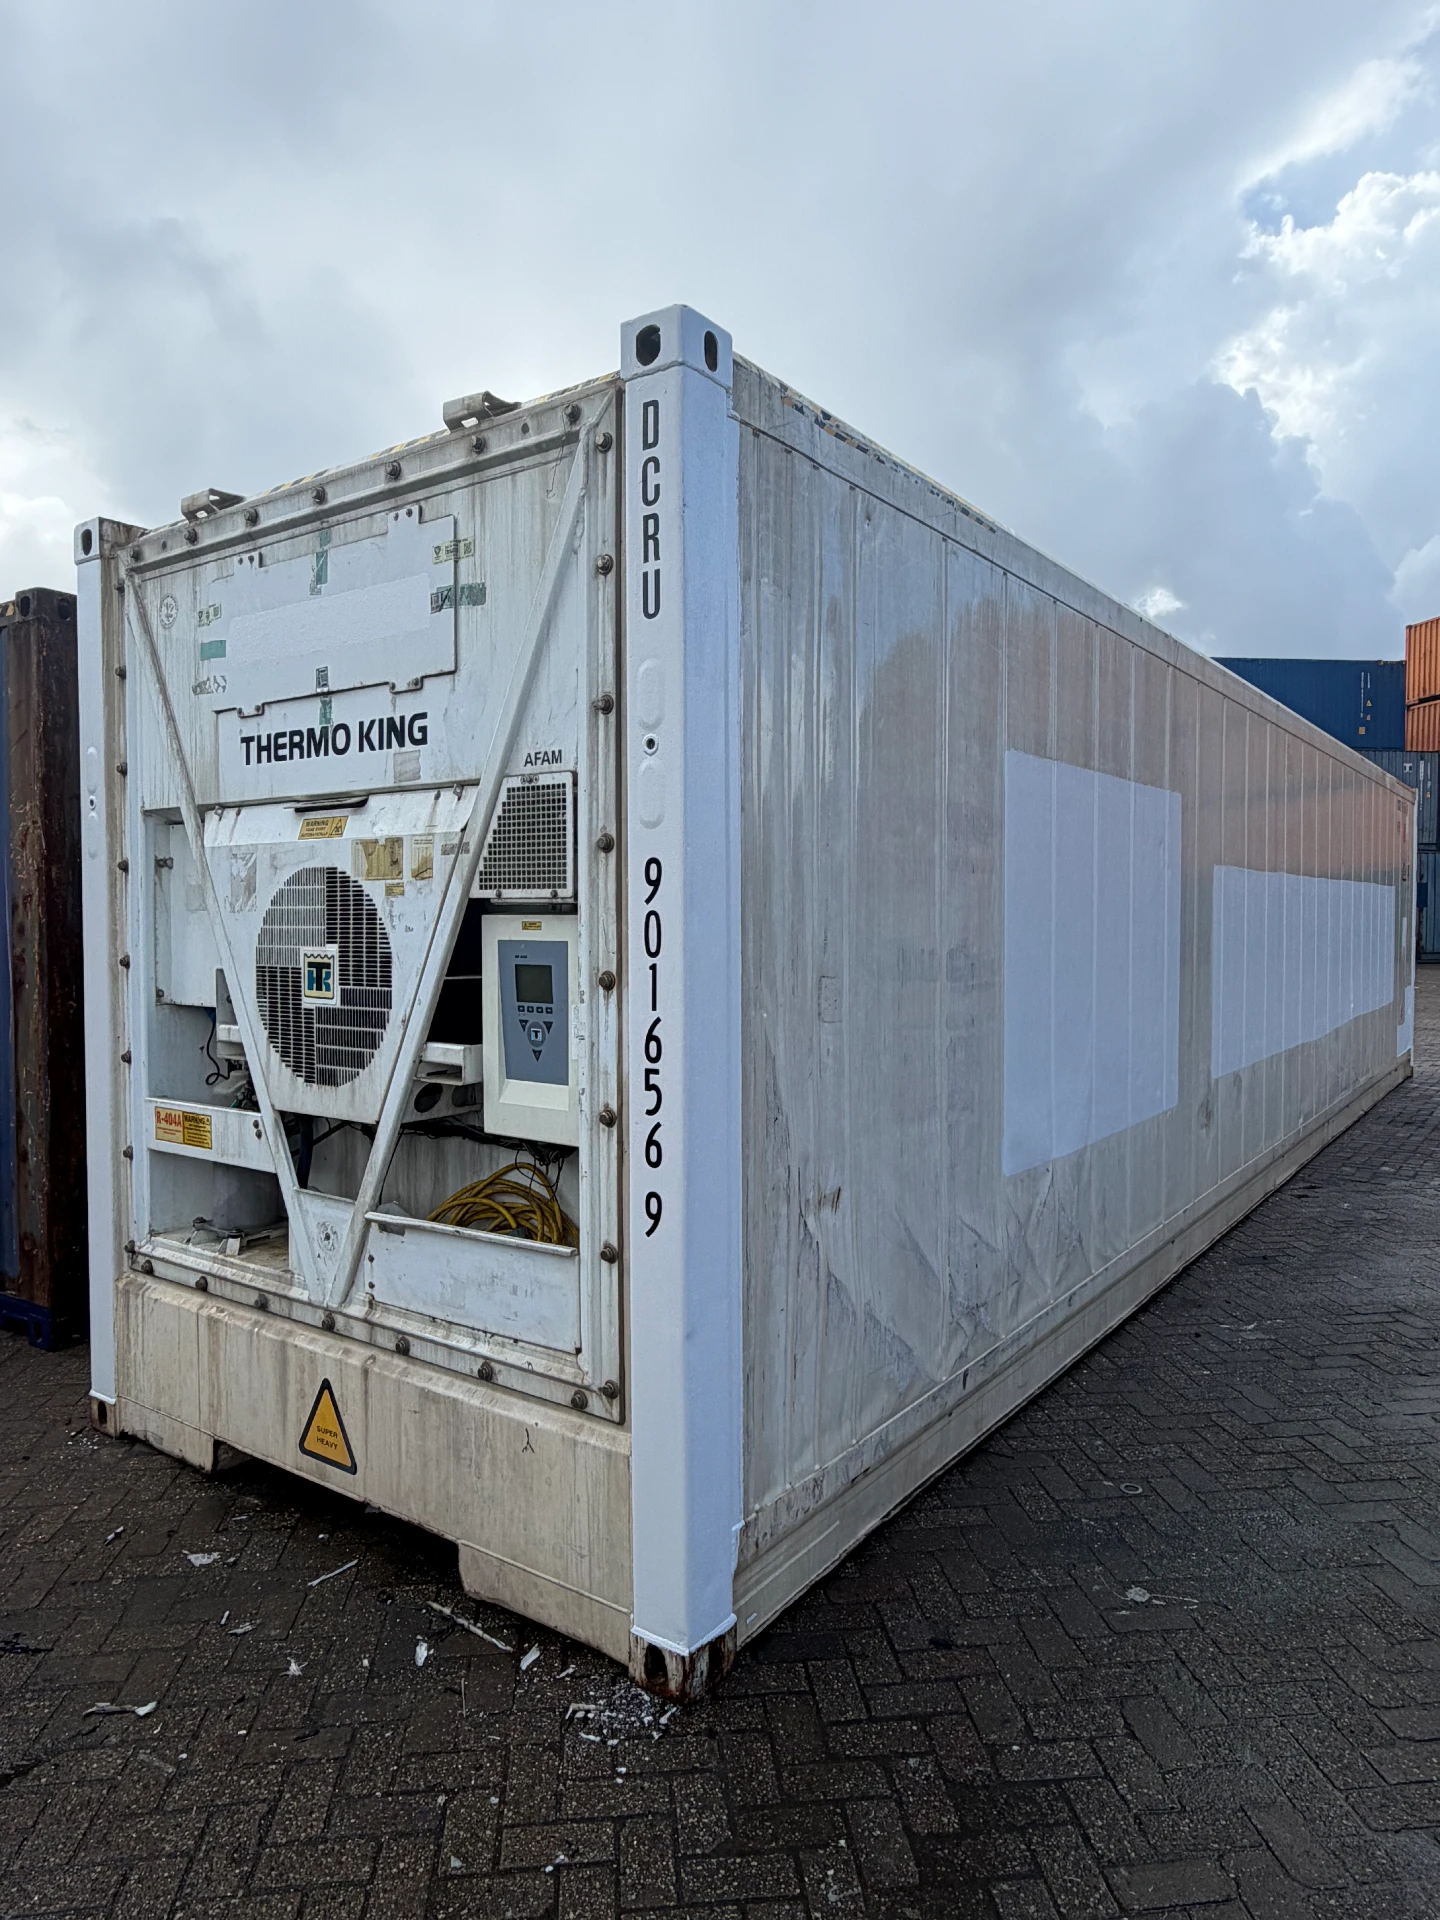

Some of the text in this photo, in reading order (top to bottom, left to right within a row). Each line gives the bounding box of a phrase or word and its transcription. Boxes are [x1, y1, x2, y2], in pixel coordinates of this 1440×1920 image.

[240, 712, 428, 766] THERMO KING
[523, 749, 563, 768] AFAM
[305, 819, 330, 827] WARNING
[641, 399, 663, 1238] DCRU 901656 9
[156, 1111, 182, 1128] R-404A
[316, 1425, 338, 1439] SUPER
[316, 1436, 338, 1450] HEAVY
